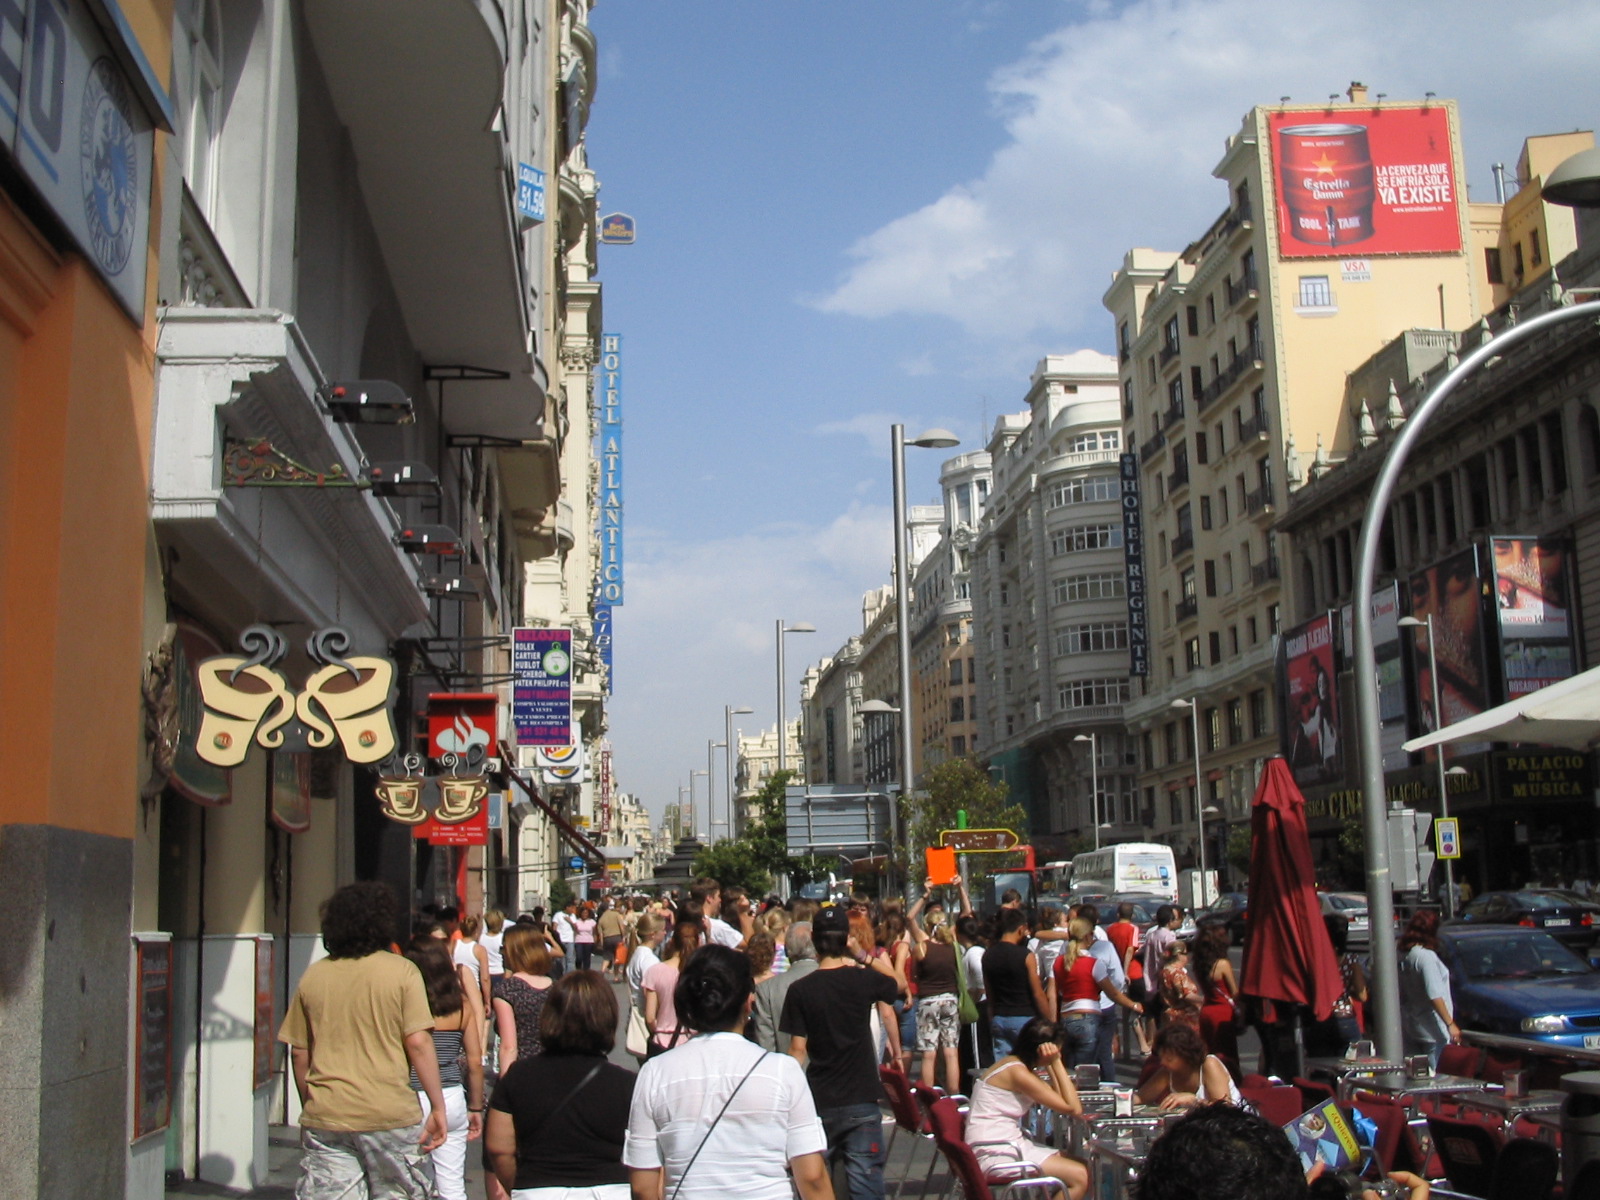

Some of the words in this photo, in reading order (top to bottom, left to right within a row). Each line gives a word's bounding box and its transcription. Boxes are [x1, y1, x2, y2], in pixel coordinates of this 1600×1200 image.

[1376, 166, 1388, 176] LA
[1388, 164, 1429, 176] CERVEZA
[1429, 163, 1448, 174] QUE
[1304, 178, 1349, 189] Estrella
[1377, 176, 1389, 187] SE
[1425, 174, 1450, 186] SOLA
[1313, 190, 1344, 199] Damm
[1378, 188, 1398, 205] YA
[1399, 186, 1452, 204] EXISTE
[1300, 217, 1322, 230] COOL
[1338, 216, 1360, 229] TANK
[604, 336, 620, 424] HOTEL
[604, 436, 621, 601] ATLANTICO
[1122, 480, 1139, 556] HOTEL
[1128, 563, 1146, 674] REGENTE
[516, 630, 570, 640] RELOJES
[515, 642, 535, 650] ROLEX
[515, 652, 541, 660] CARTIER
[515, 661, 540, 669] HUBLOT
[515, 670, 547, 678] CHERON
[515, 680, 532, 688] PATEK
[1507, 756, 1584, 770] PALACIO
[1528, 772, 1544, 781] DE
[1551, 771, 1566, 781] LA
[1386, 781, 1421, 802] ALACIO
[1446, 770, 1480, 794] USICA
[1512, 782, 1582, 797] MUSICA
